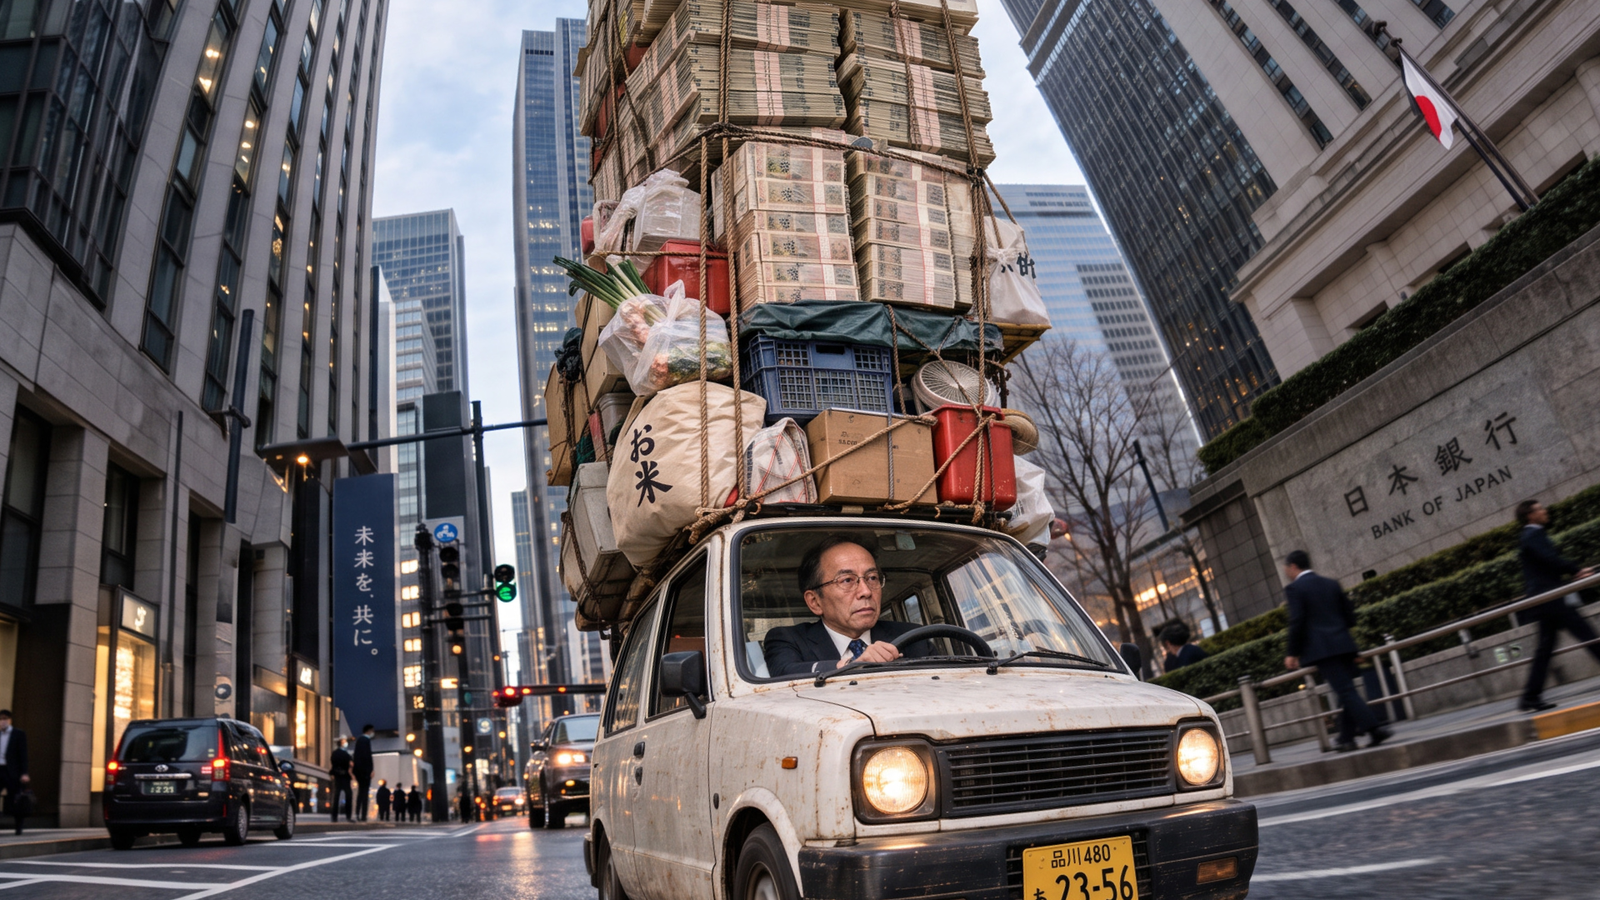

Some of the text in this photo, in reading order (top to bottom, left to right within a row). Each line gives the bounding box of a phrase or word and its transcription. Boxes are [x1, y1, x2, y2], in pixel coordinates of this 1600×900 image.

[630, 424, 673, 508] お米
[1343, 411, 1518, 518] 日本銀行
[1370, 465, 1513, 540] BANK OF JAPAN
[1055, 864, 1134, 900] 23-56
